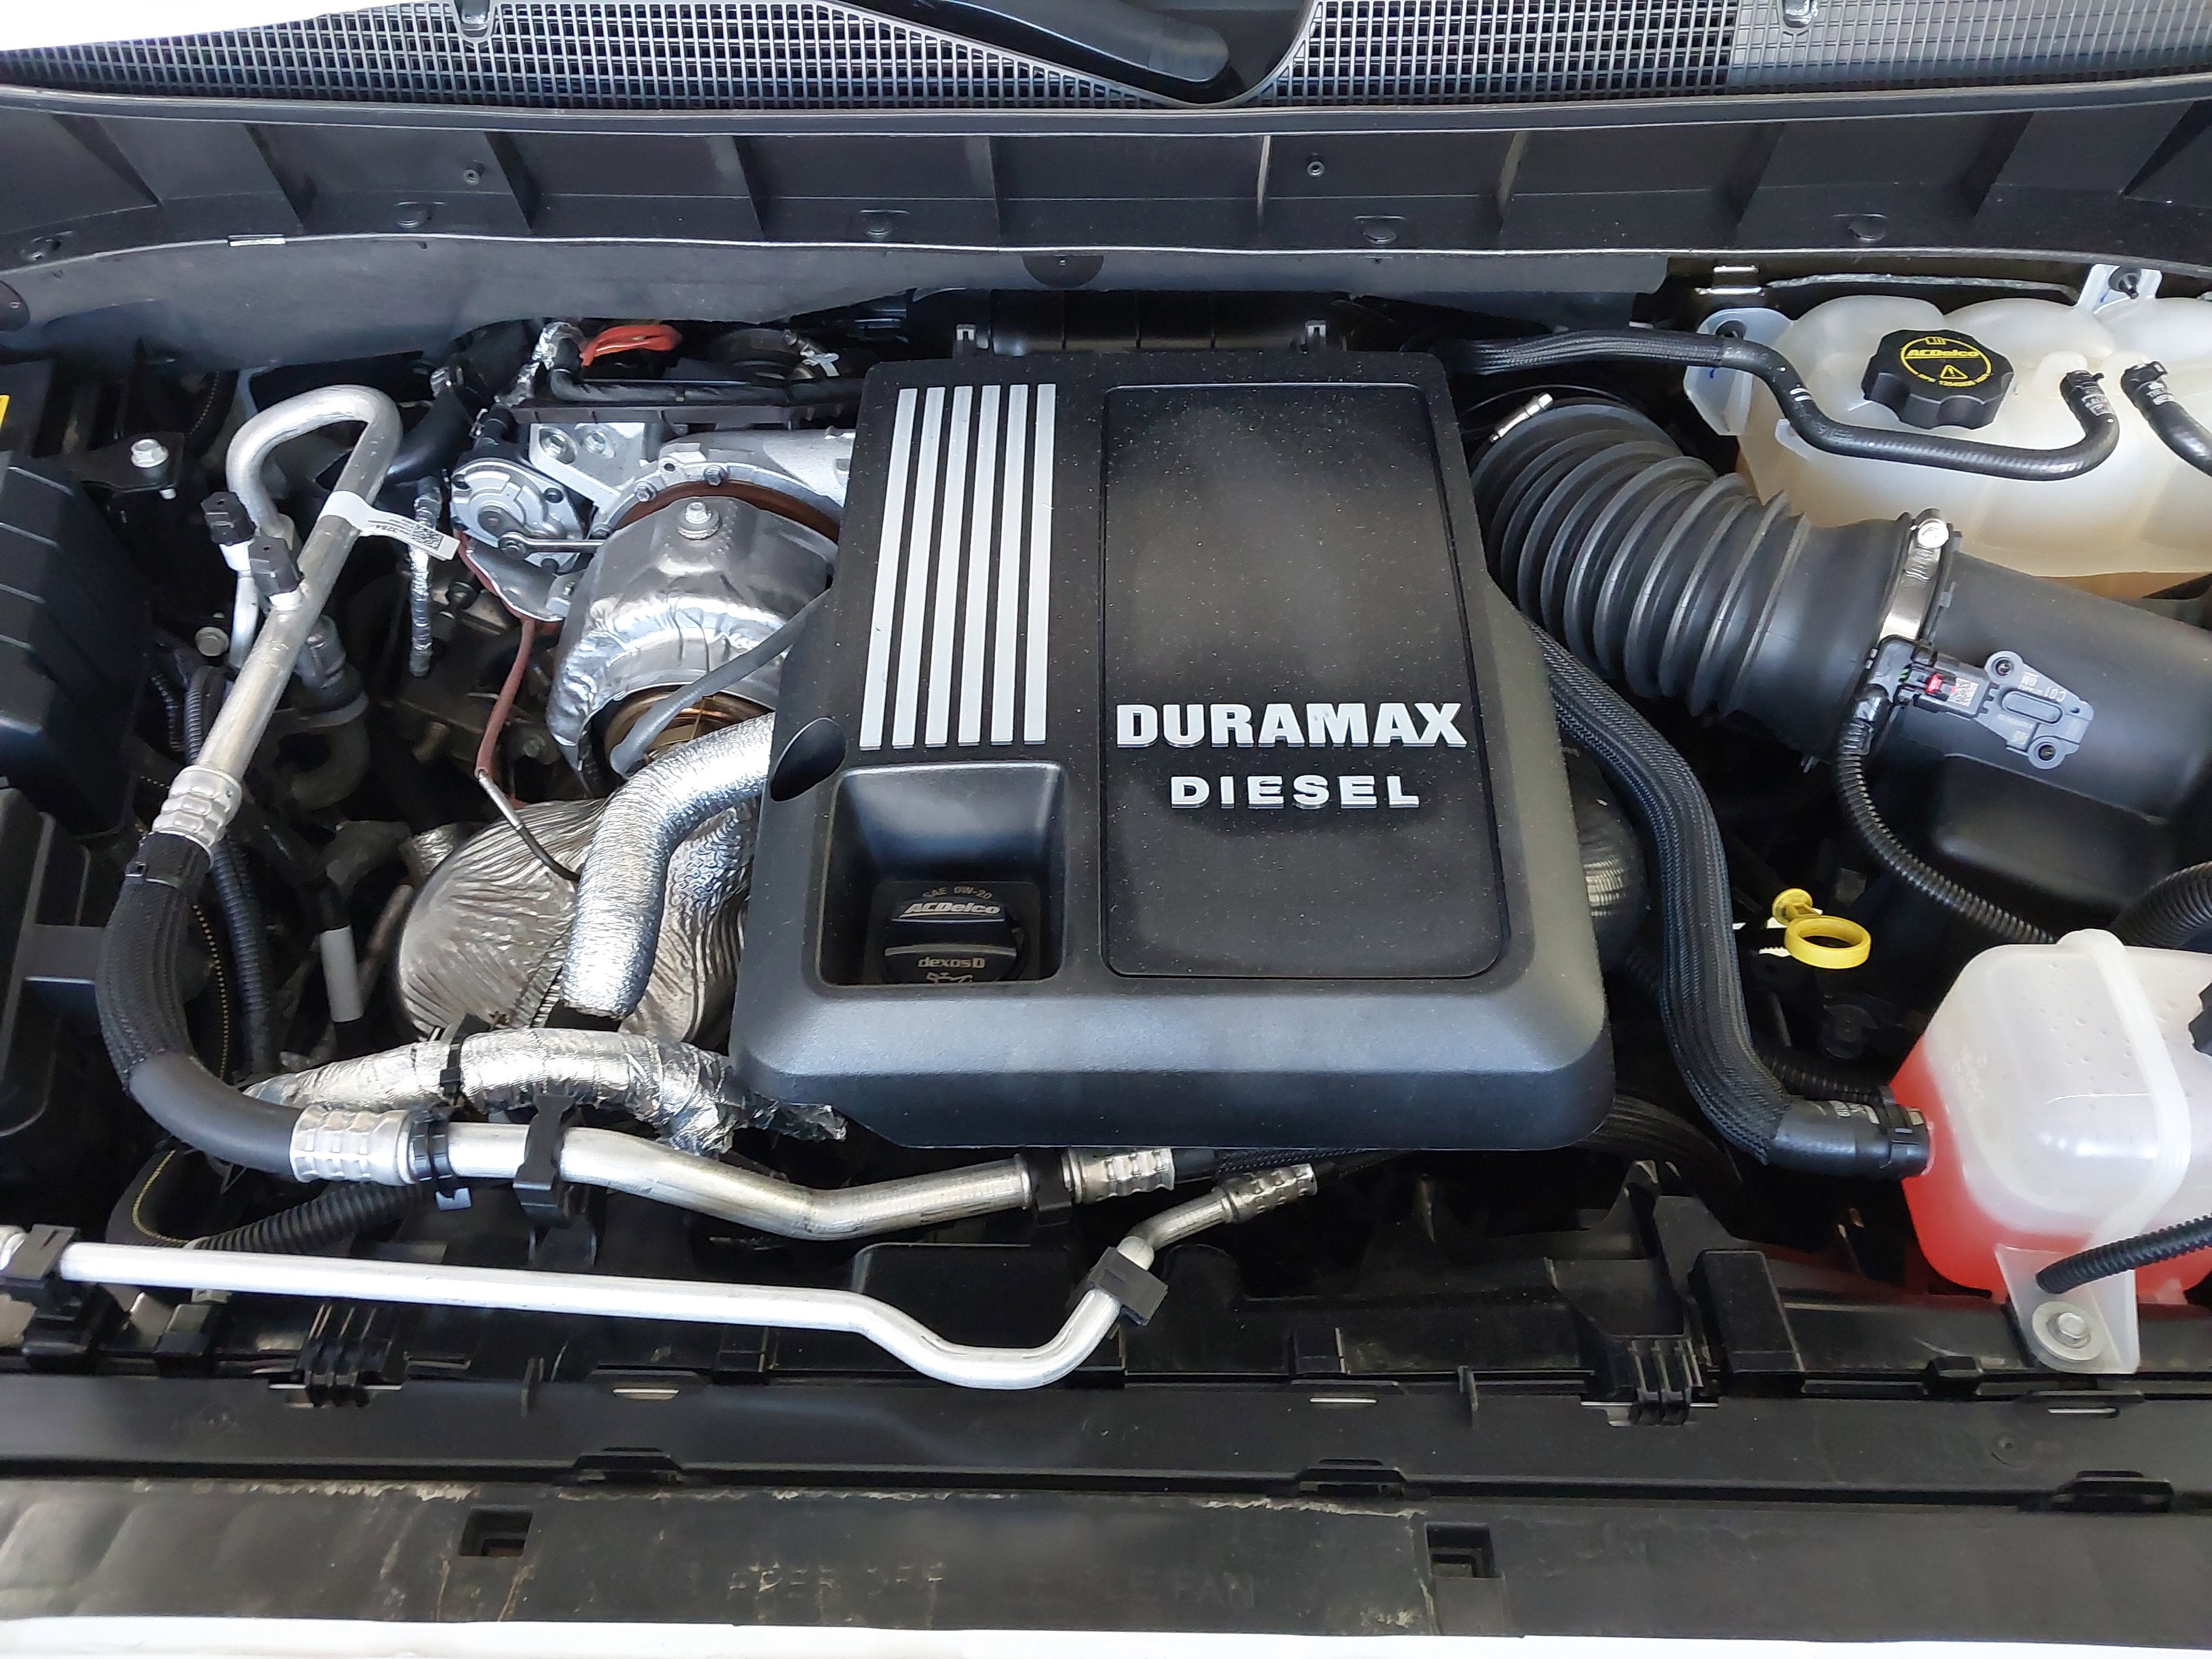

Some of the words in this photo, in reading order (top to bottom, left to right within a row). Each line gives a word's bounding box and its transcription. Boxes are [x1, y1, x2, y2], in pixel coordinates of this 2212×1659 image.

[1116, 703, 1468, 748] DURAMAX
[1170, 775, 1420, 809] DIESEL
[922, 887, 948, 898] SAE
[954, 886, 993, 900] 0W-20
[904, 902, 1000, 915] ACDelco
